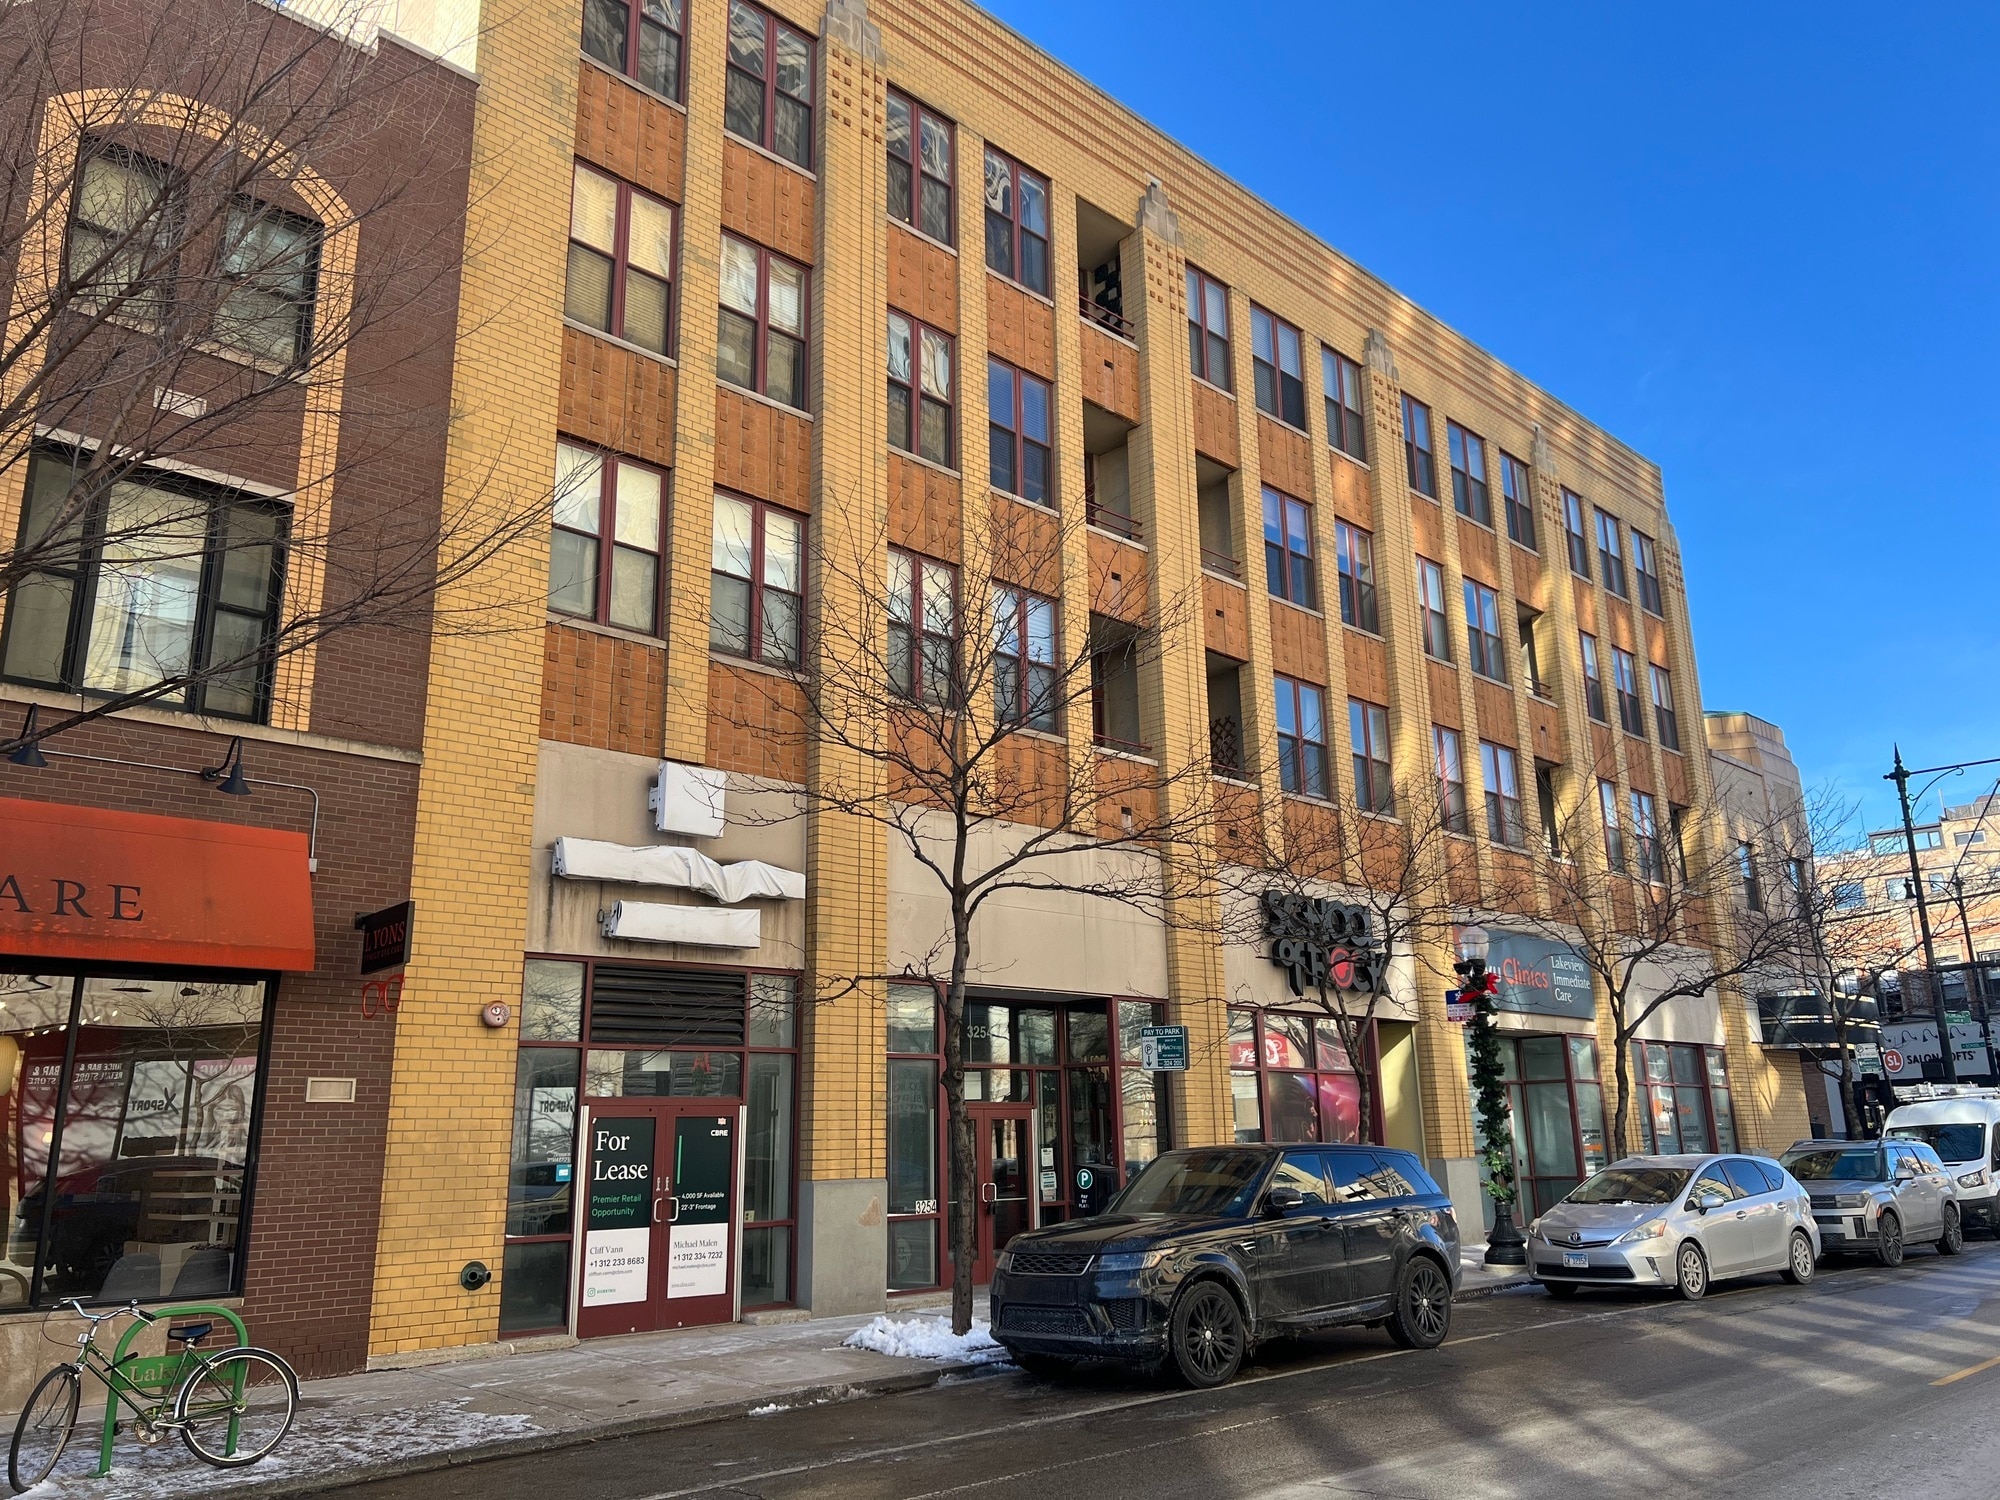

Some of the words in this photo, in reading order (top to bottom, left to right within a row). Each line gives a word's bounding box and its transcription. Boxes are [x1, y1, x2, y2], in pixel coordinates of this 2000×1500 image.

[365, 921, 405, 952] LYONS
[1551, 955, 1585, 972] Lakeview
[1502, 958, 1549, 989] Clinics
[1553, 972, 1591, 990] Immediate
[1554, 987, 1574, 1003] Care
[1886, 1055, 1901, 1067] SL
[1907, 1053, 1940, 1064] SALON
[710, 1129, 729, 1137] CBRE
[595, 1130, 631, 1151] For
[593, 1160, 649, 1181] Lease
[592, 1195, 620, 1204] Premier
[621, 1194, 642, 1203] Retail
[703, 1191, 725, 1199] Available
[591, 1207, 635, 1218] Opportunity
[695, 1203, 717, 1211] Frontage
[916, 1200, 936, 1214] 3254
[589, 1246, 605, 1255] Cliff
[605, 1245, 624, 1254] Vann
[673, 1240, 698, 1249] Michael
[698, 1239, 718, 1248] Malen
[598, 1259, 611, 1268] 312
[612, 1258, 626, 1267] 233
[626, 1256, 645, 1266] 8683
[681, 1253, 693, 1261] 312
[707, 1251, 723, 1259] 7232
